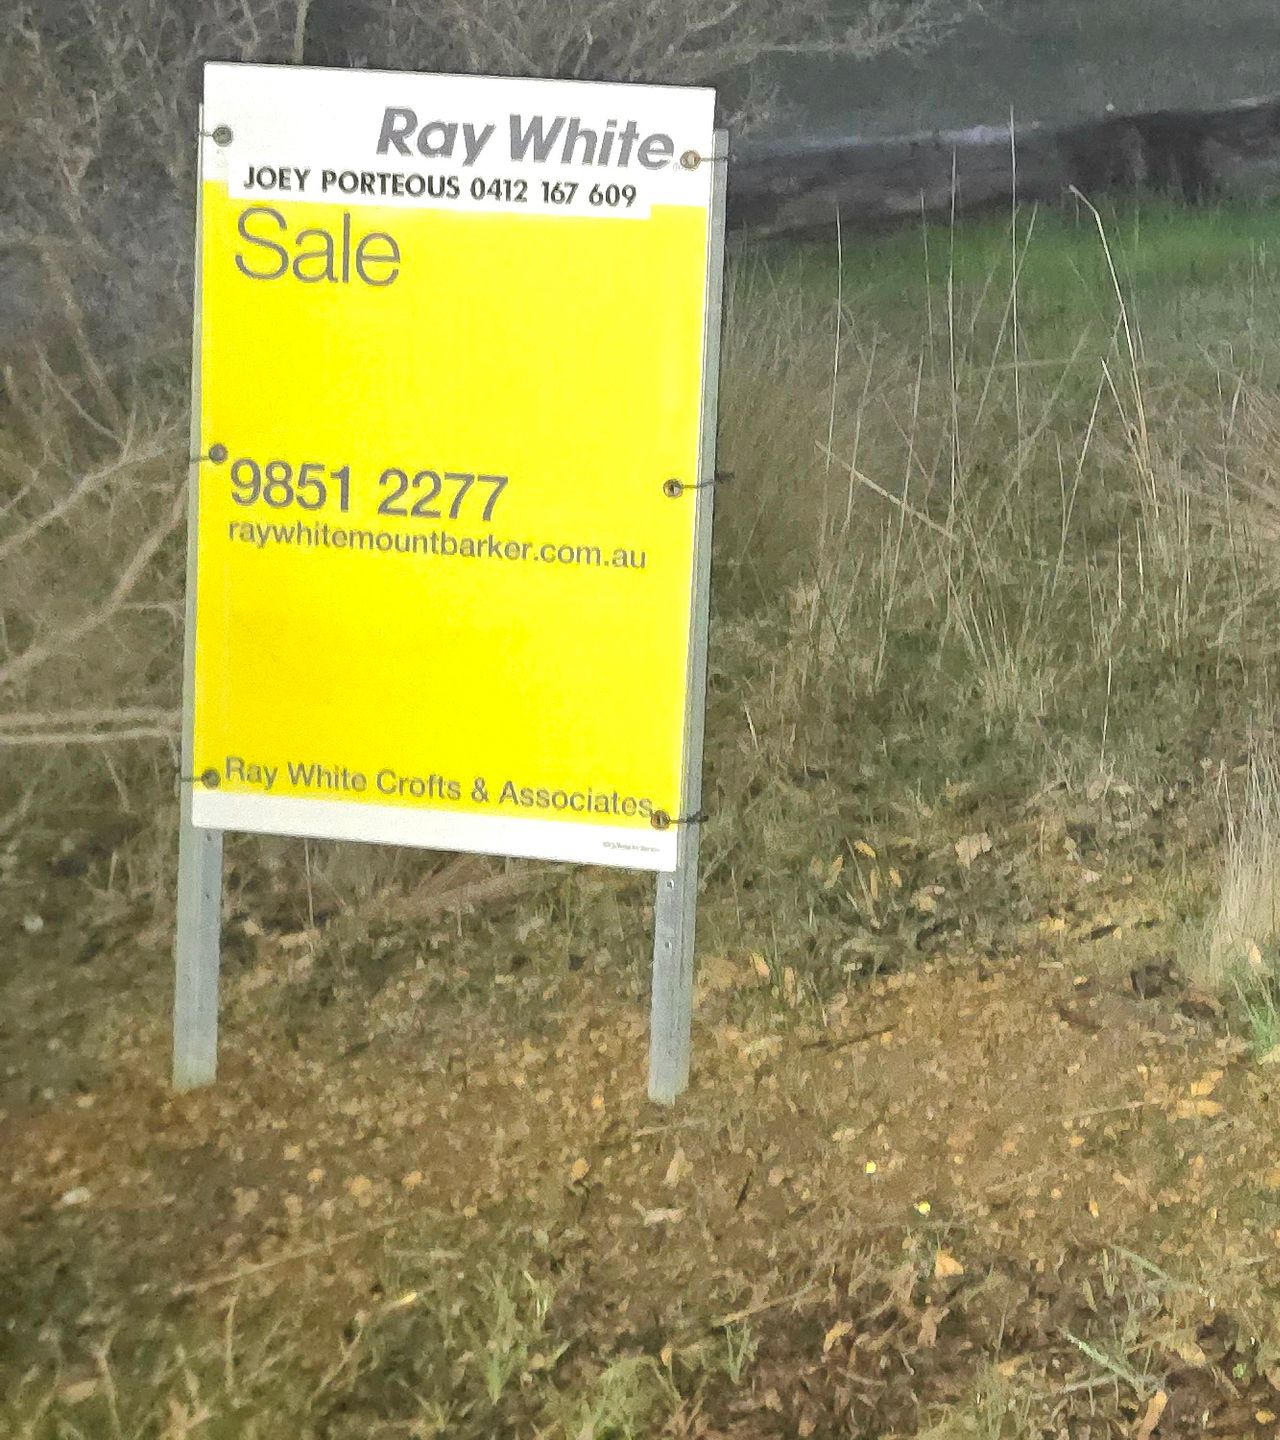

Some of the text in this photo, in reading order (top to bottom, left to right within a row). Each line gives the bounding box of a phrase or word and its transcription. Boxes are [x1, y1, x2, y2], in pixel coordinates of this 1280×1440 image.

[378, 106, 676, 172] Ray White
[243, 166, 637, 208] JOEY PORTEOUS 0412 167 609
[234, 207, 401, 287] Sale
[230, 459, 509, 522] 9851 2277
[229, 521, 646, 569] raywhitemountbarker.com.au
[224, 756, 654, 819] Ray White Crofts & Associates
